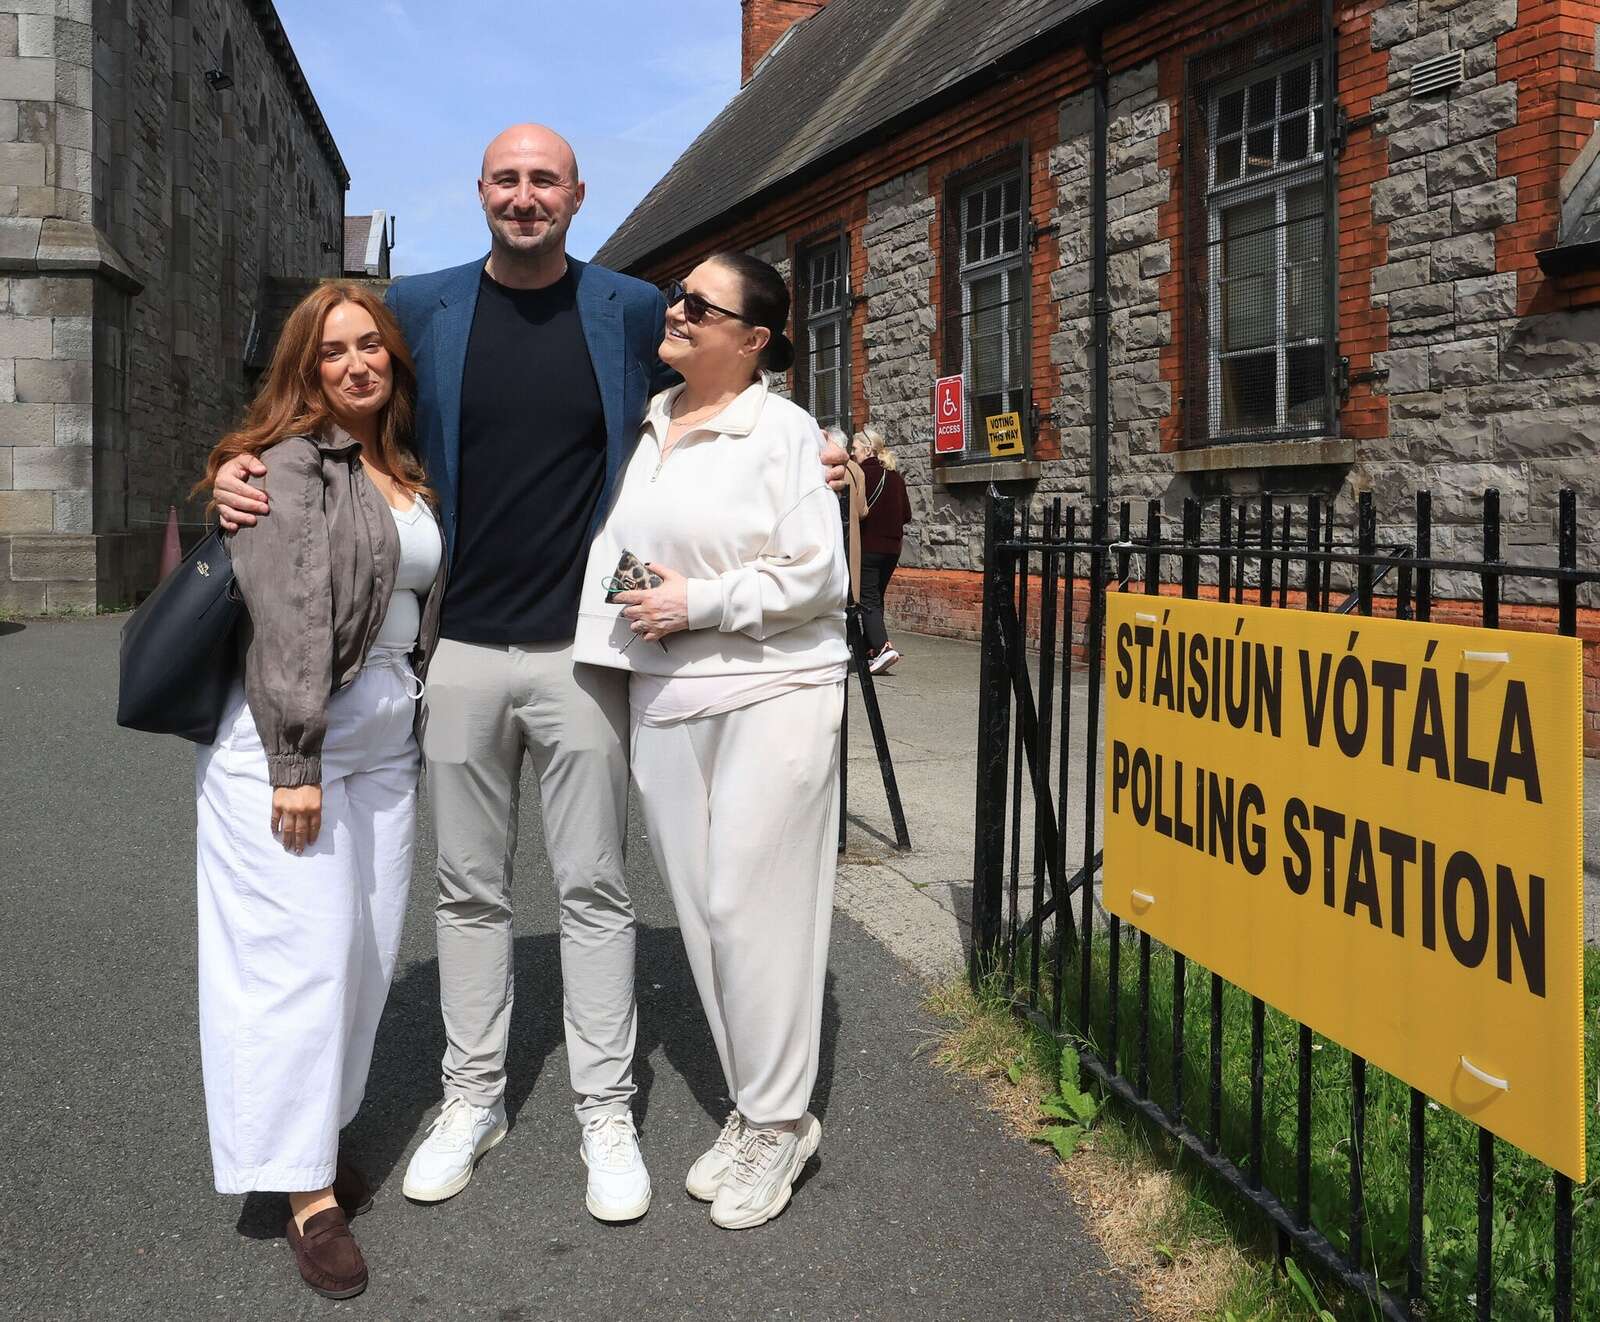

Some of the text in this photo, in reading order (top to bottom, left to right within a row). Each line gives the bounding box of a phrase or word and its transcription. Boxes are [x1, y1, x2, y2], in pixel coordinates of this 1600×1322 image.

[991, 416, 1014, 429] VOTING
[938, 425, 961, 435] ACCESS
[989, 430, 1018, 443] THIS WAY
[1116, 609, 1543, 804] STÁISIÚN VÓTÁLA
[1112, 740, 1546, 999] POLLING STATION
